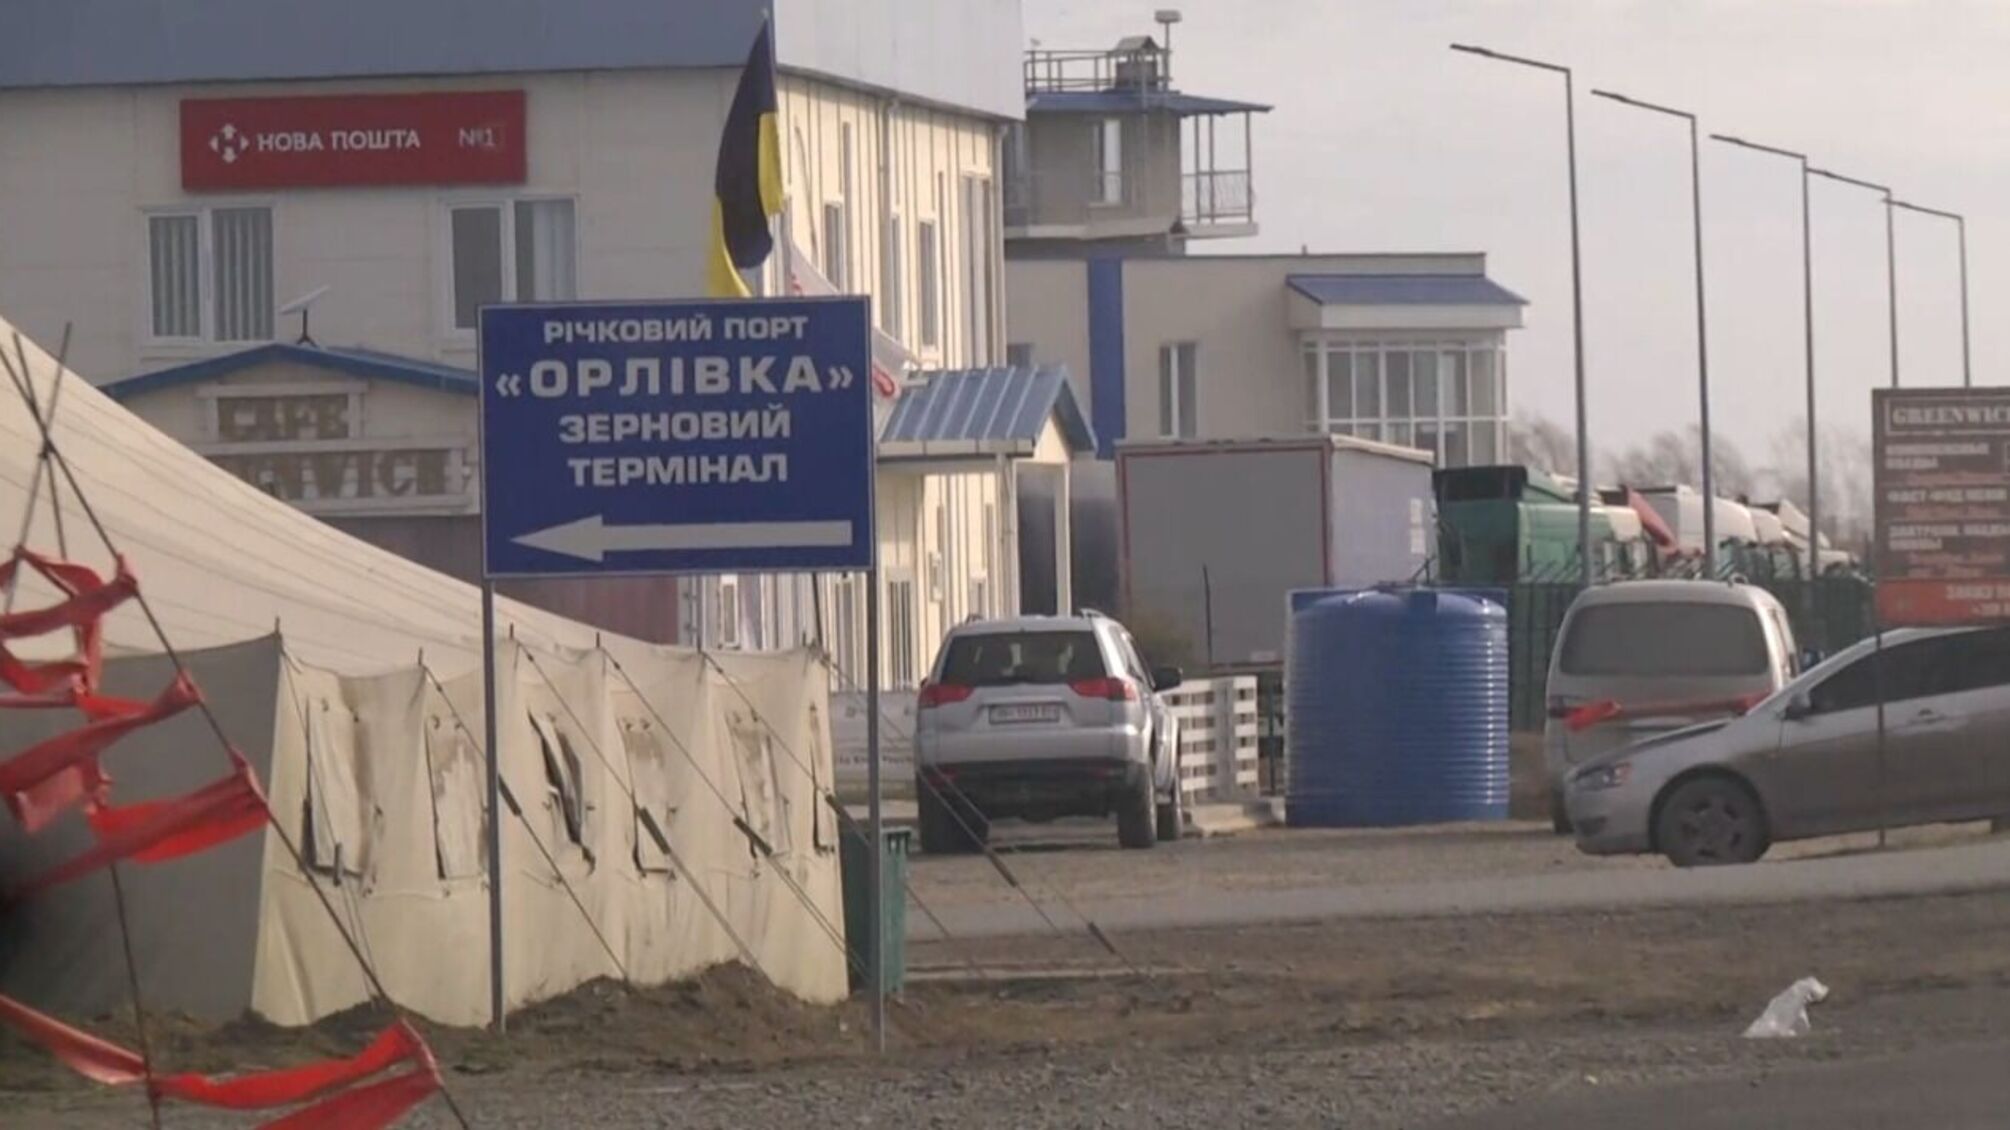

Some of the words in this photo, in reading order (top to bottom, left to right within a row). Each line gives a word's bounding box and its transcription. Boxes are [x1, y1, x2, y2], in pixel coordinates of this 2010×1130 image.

[257, 132, 324, 152] НОВА
[331, 128, 421, 151] ПОШТА
[543, 313, 713, 344] РІЧКОВИЙ
[723, 316, 809, 341] ПОРТ
[495, 355, 855, 399] «ОРЛІВКА»
[558, 403, 792, 444] ЗЕРНОВИЙ
[567, 453, 789, 488] ТЕРМІНАЛ
